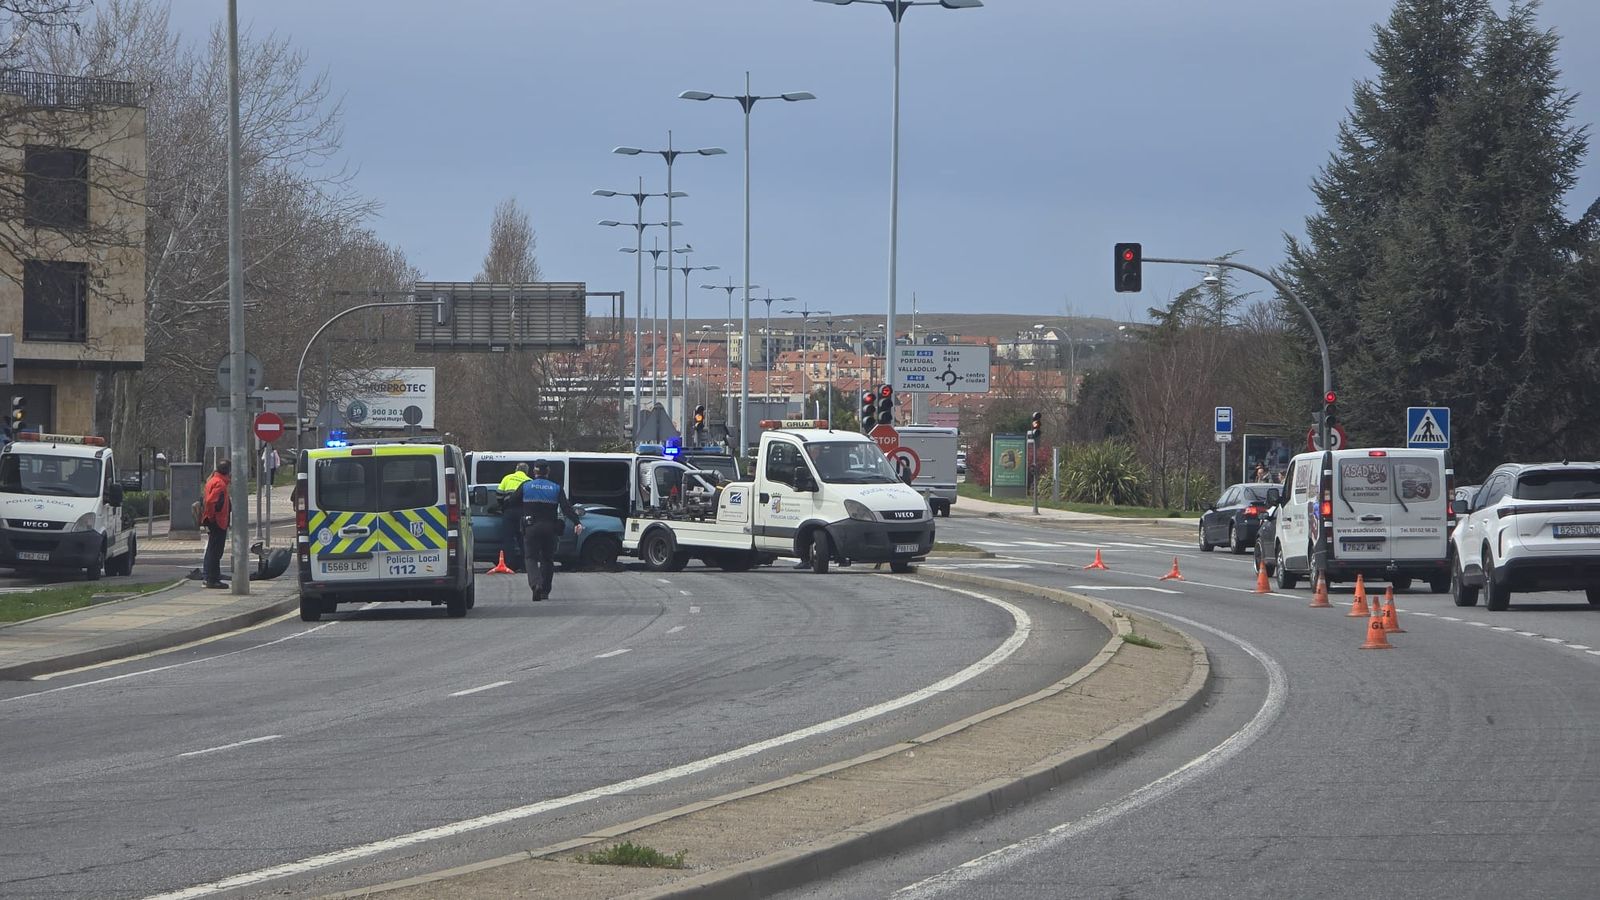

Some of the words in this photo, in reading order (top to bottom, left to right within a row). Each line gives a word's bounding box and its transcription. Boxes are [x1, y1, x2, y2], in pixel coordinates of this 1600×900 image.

[317, 459, 332, 467] 717
[23, 520, 49, 528] IVECO
[386, 554, 414, 564] Policía
[418, 554, 440, 563] Local
[327, 562, 349, 571] 5569
[351, 561, 368, 571] LRC
[393, 565, 417, 574] 112
[1371, 621, 1384, 630] G1
